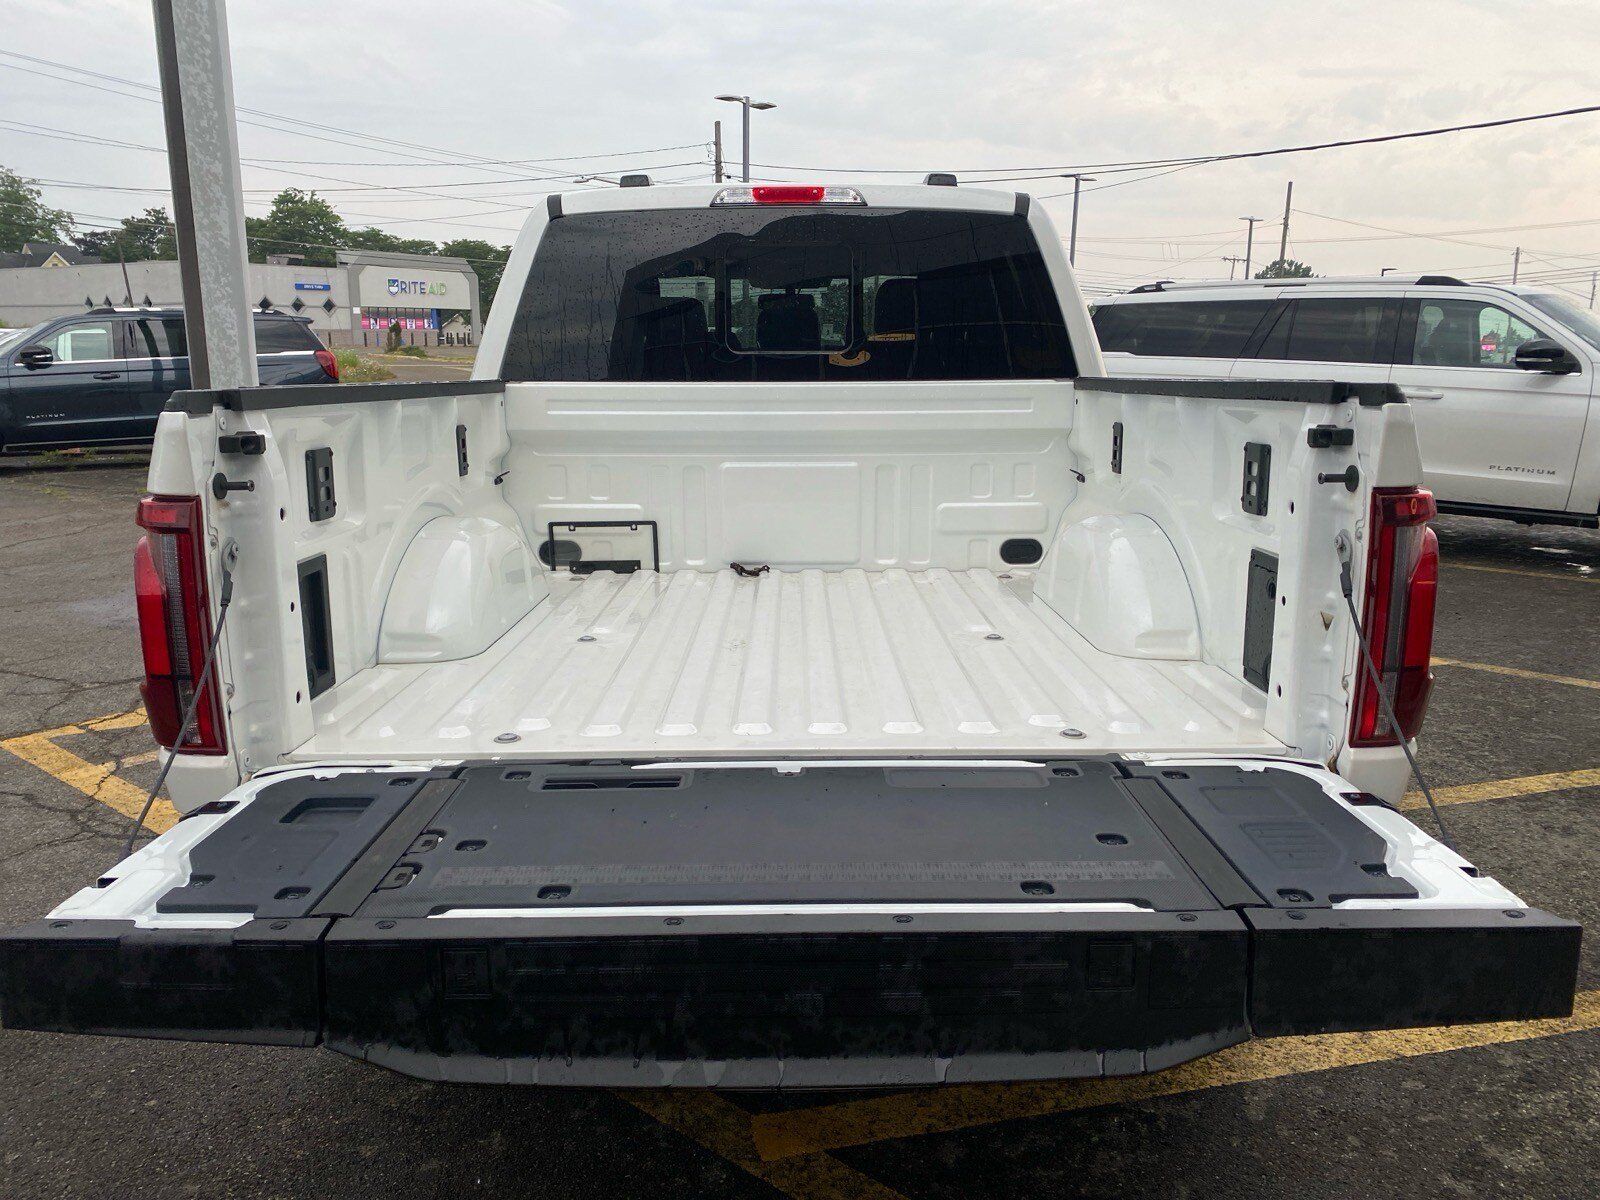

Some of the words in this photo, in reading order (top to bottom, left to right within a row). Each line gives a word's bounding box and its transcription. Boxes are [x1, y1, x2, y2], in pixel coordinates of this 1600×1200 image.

[400, 280, 426, 294] RITE
[429, 282, 447, 296] AID
[1489, 464, 1556, 476] PLATINUM
